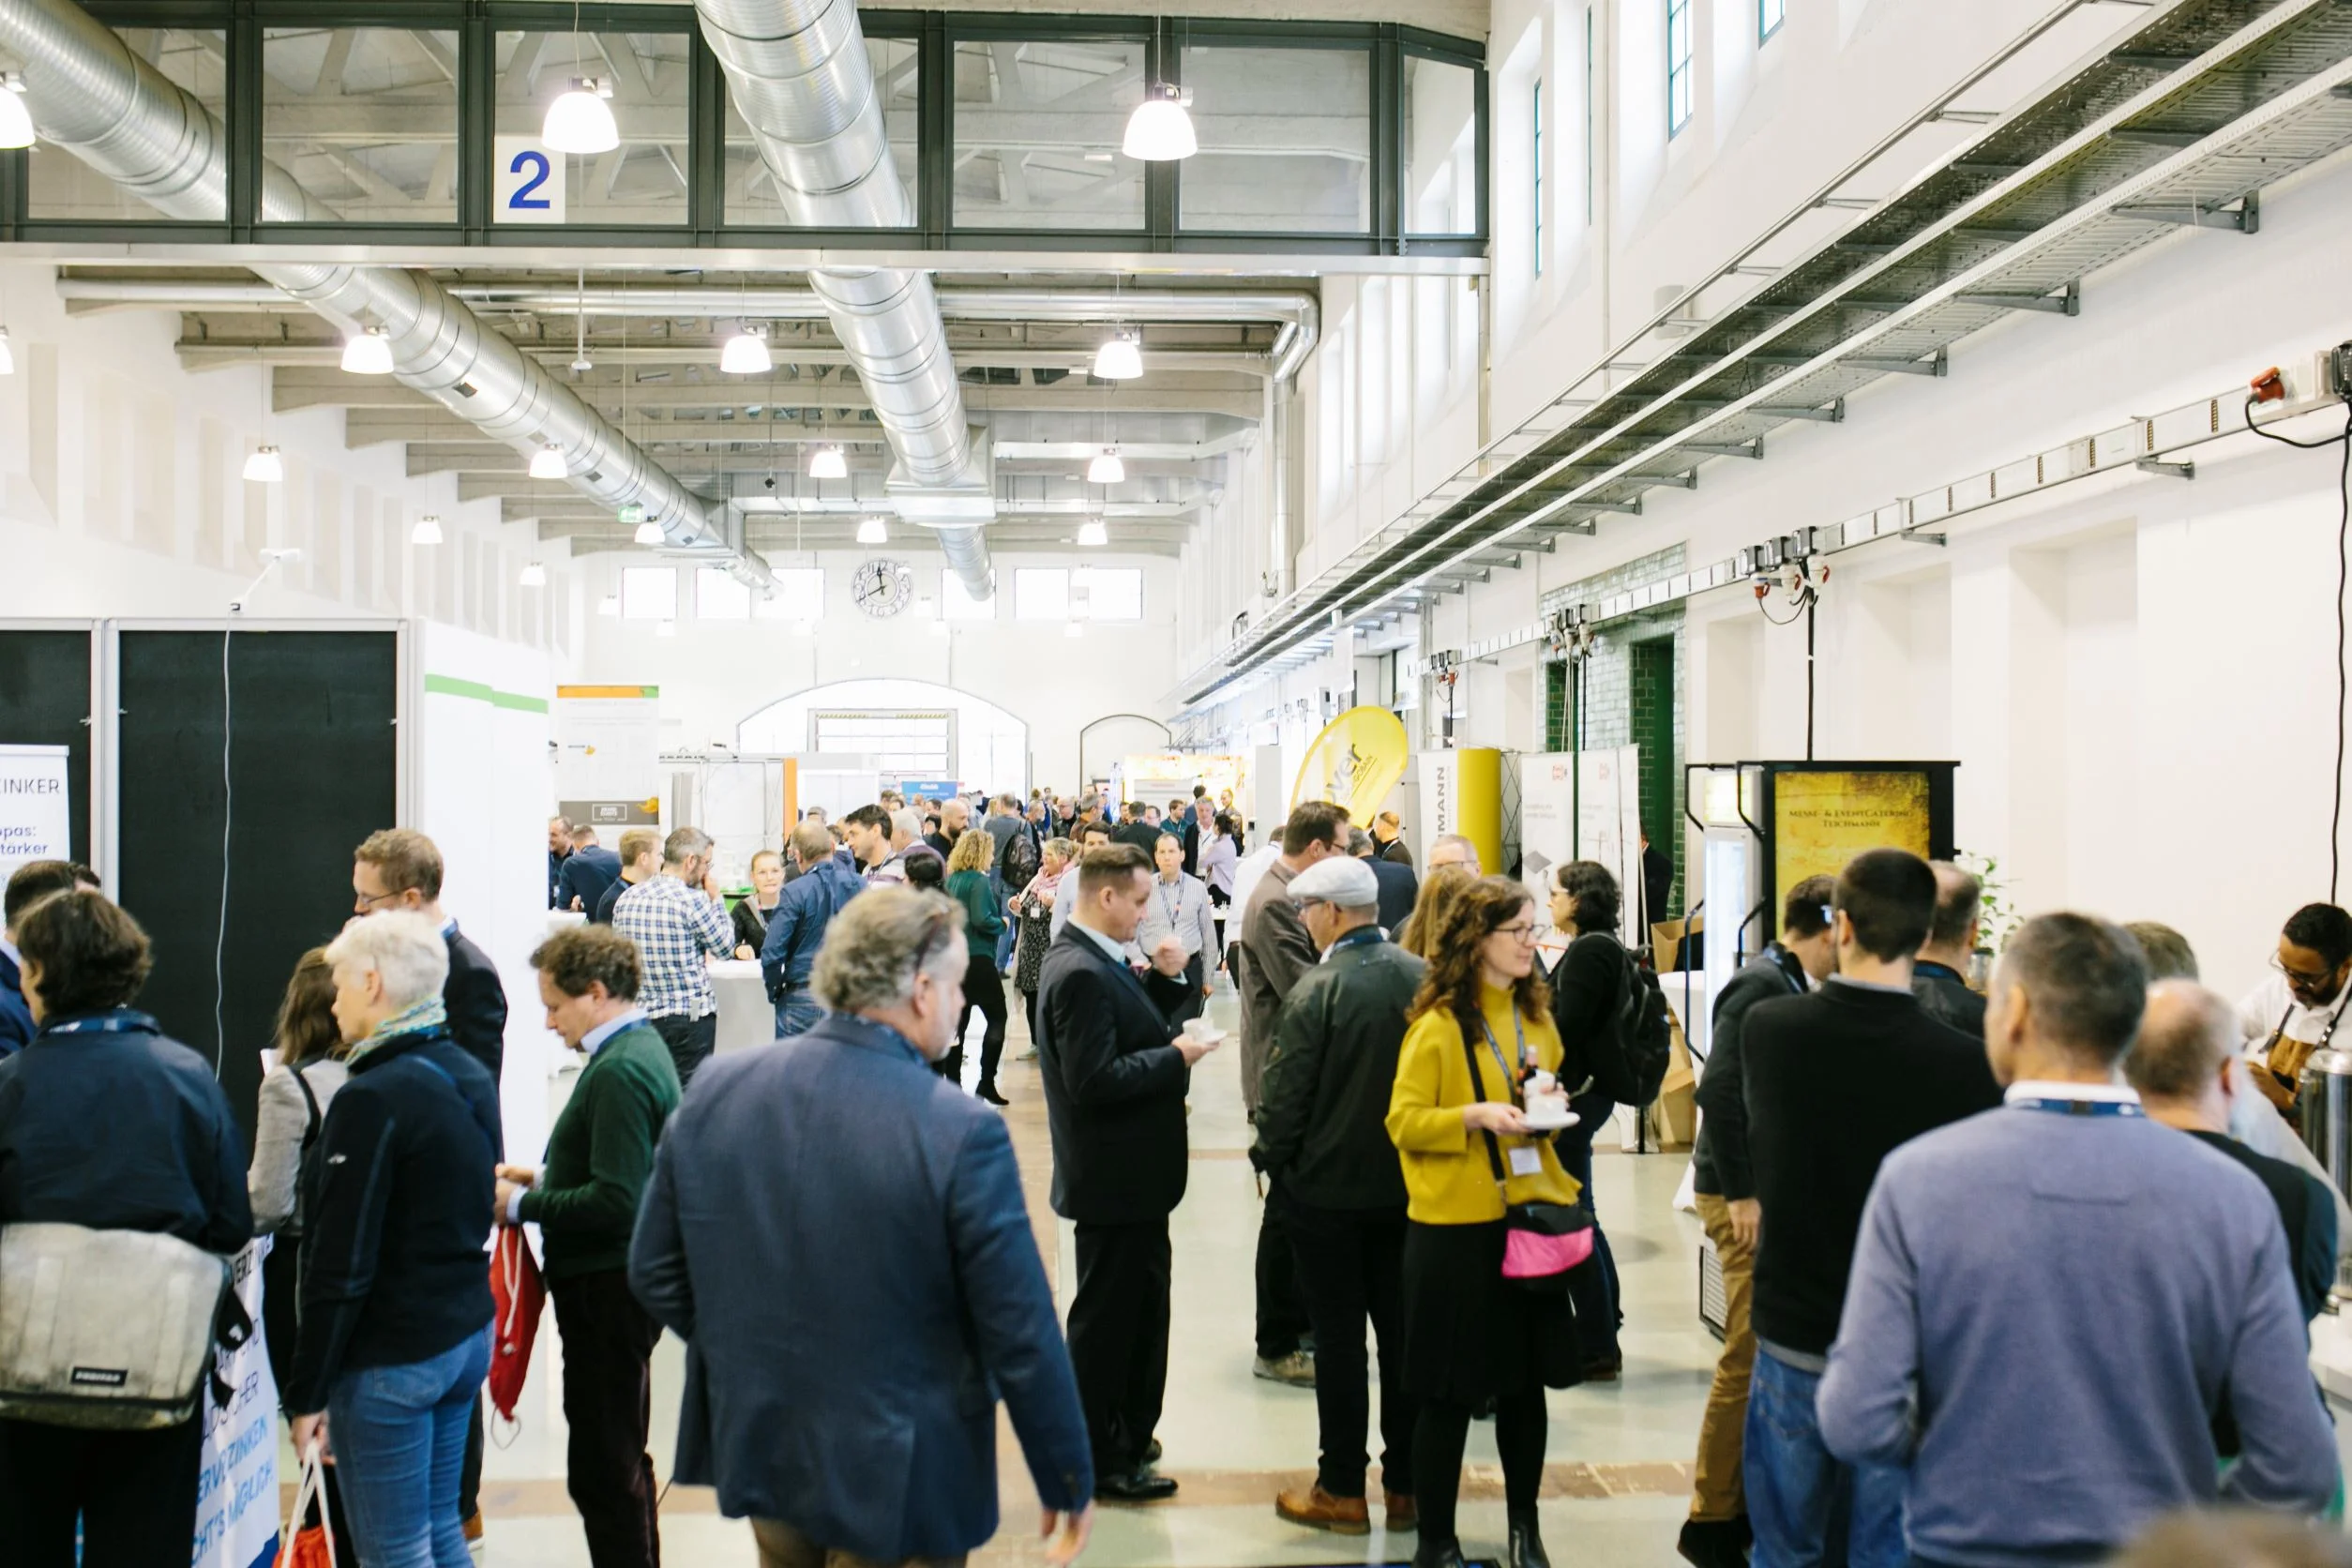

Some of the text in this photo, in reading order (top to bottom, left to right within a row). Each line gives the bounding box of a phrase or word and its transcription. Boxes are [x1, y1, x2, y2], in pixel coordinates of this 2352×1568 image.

[509, 151, 550, 209] 2
[0, 778, 60, 794] INKER
[0, 840, 48, 854] tärker
